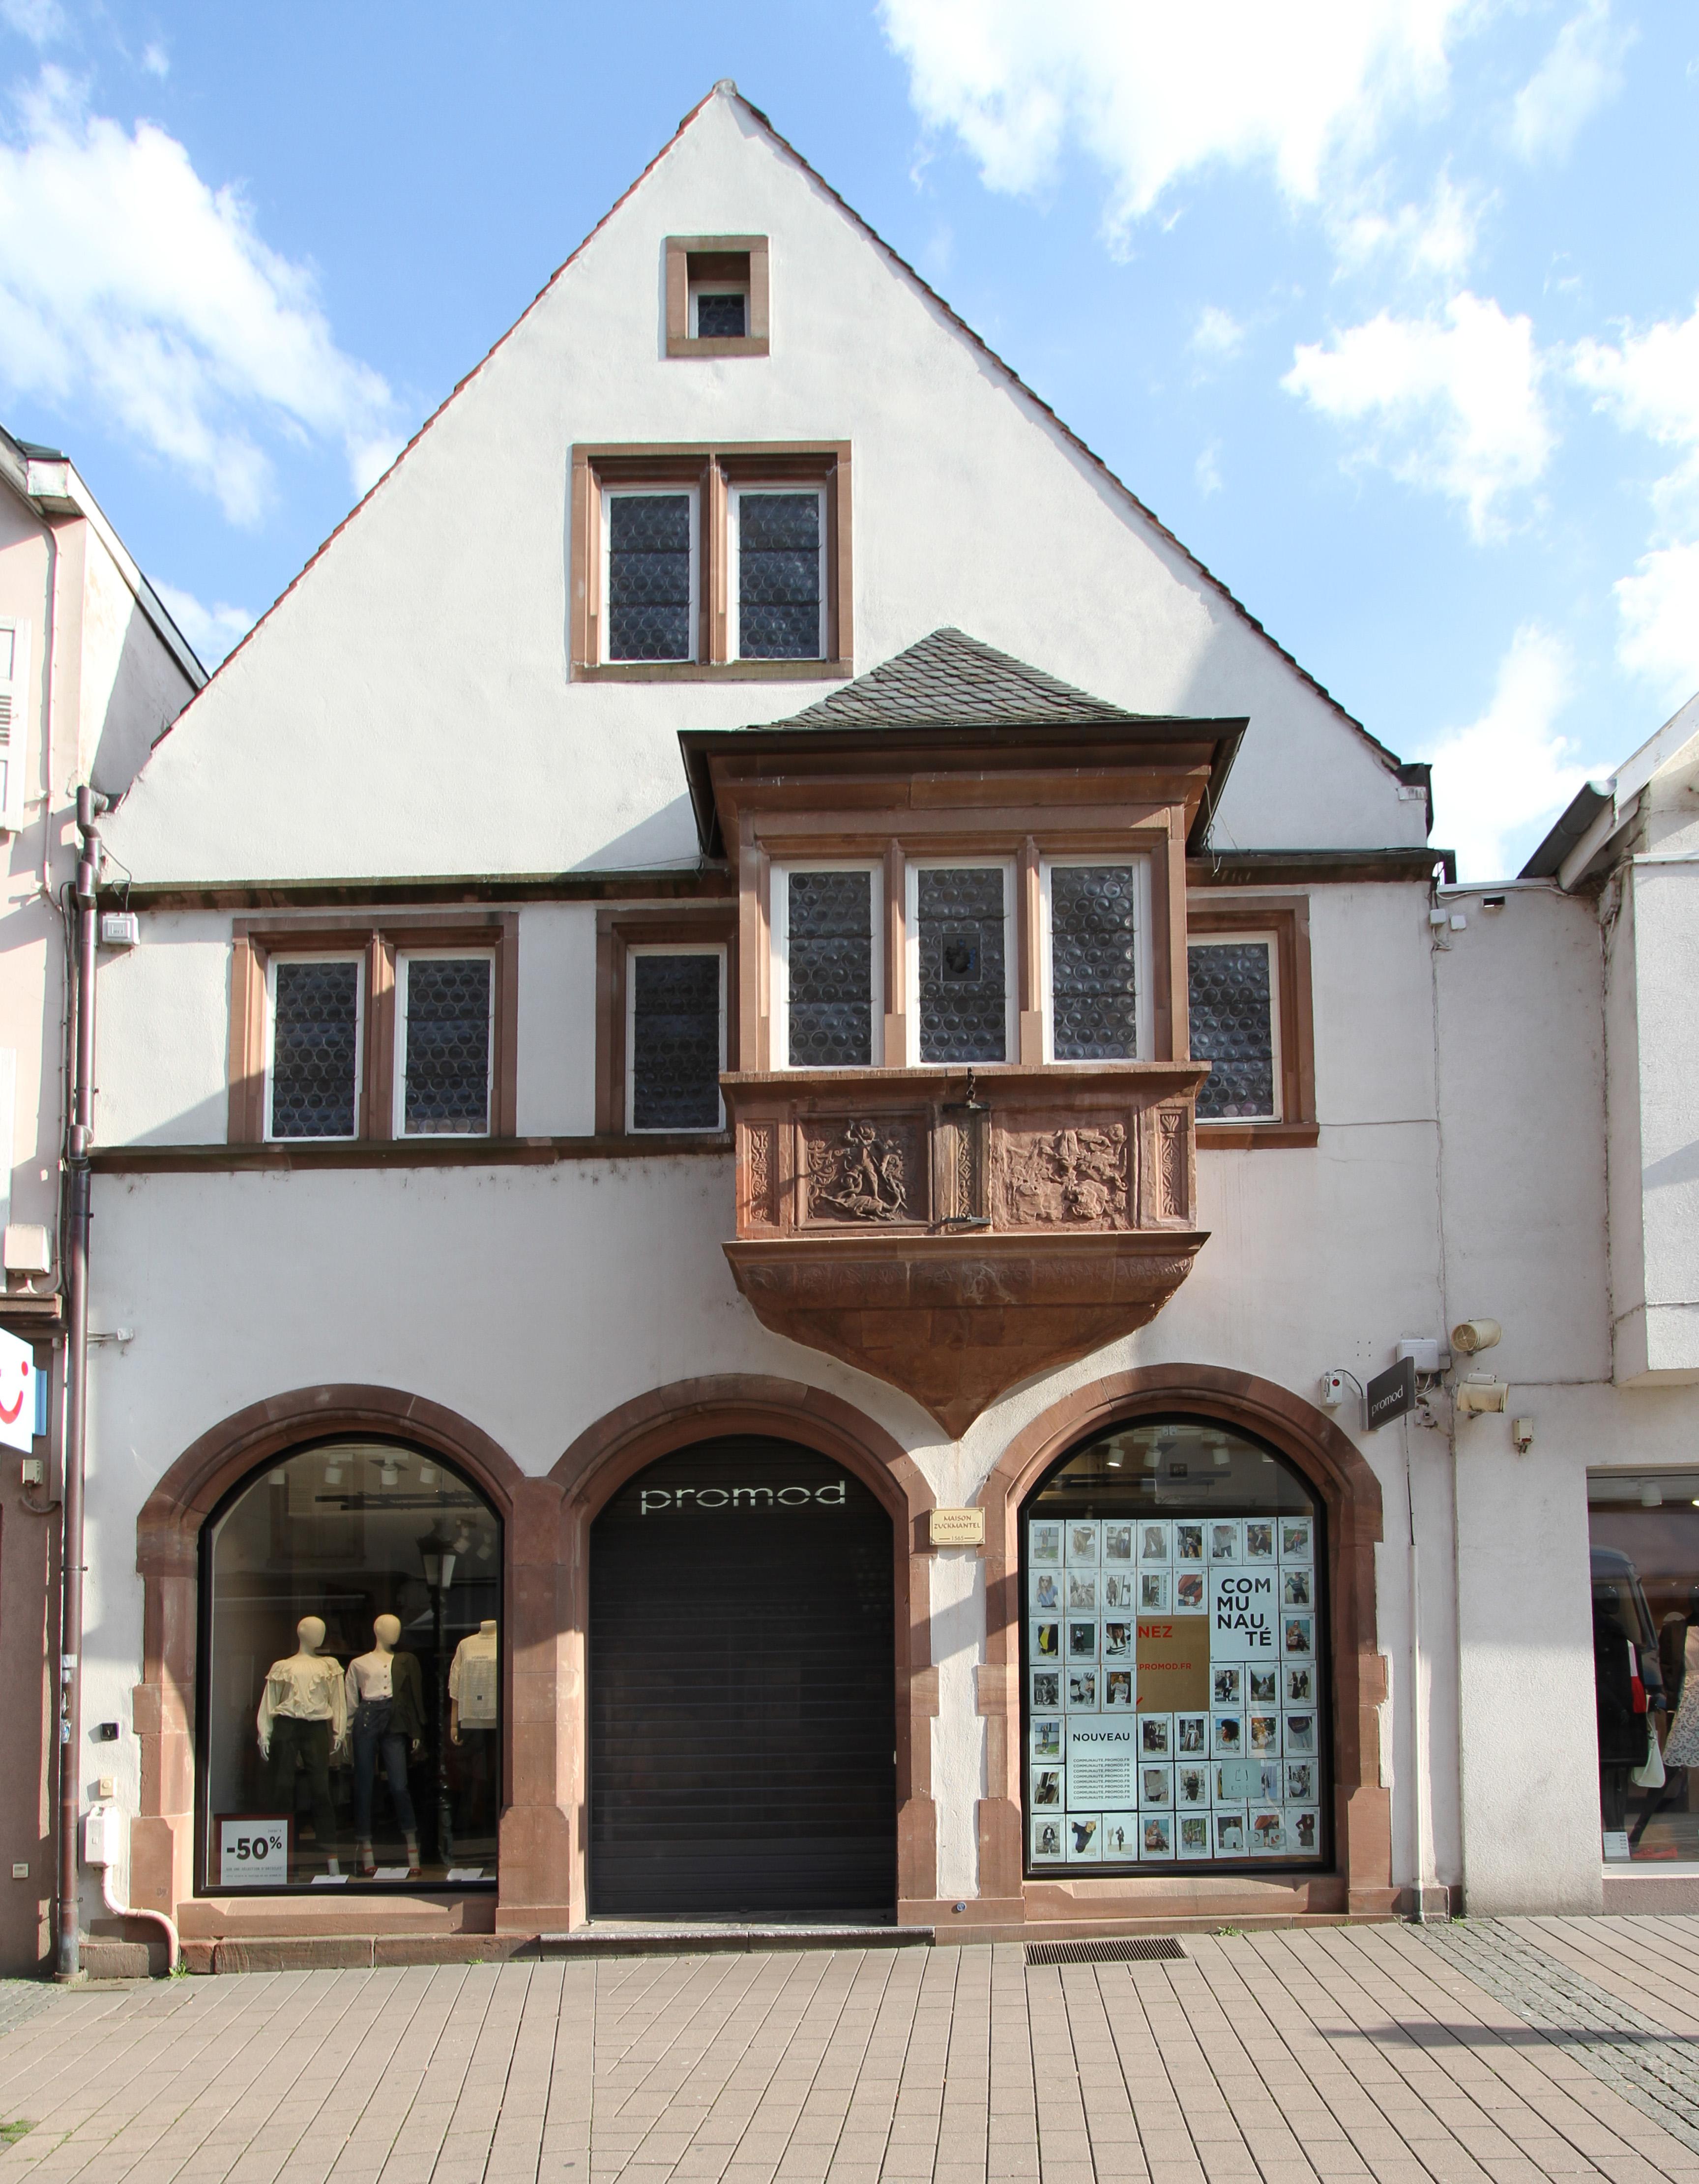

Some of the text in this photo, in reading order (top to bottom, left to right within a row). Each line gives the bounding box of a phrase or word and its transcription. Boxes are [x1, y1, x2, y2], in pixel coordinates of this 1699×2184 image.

[1371, 1385, 1403, 1417] promod
[640, 1480, 845, 1515] promod
[1221, 1578, 1270, 1594] COM
[1217, 1596, 1249, 1612] MU
[1217, 1613, 1264, 1629] NAU
[1138, 1625, 1173, 1638] NEZ
[1245, 1627, 1272, 1646] TÉ
[1073, 1733, 1130, 1741] NOUVEAU
[227, 1836, 282, 1860] -50%
